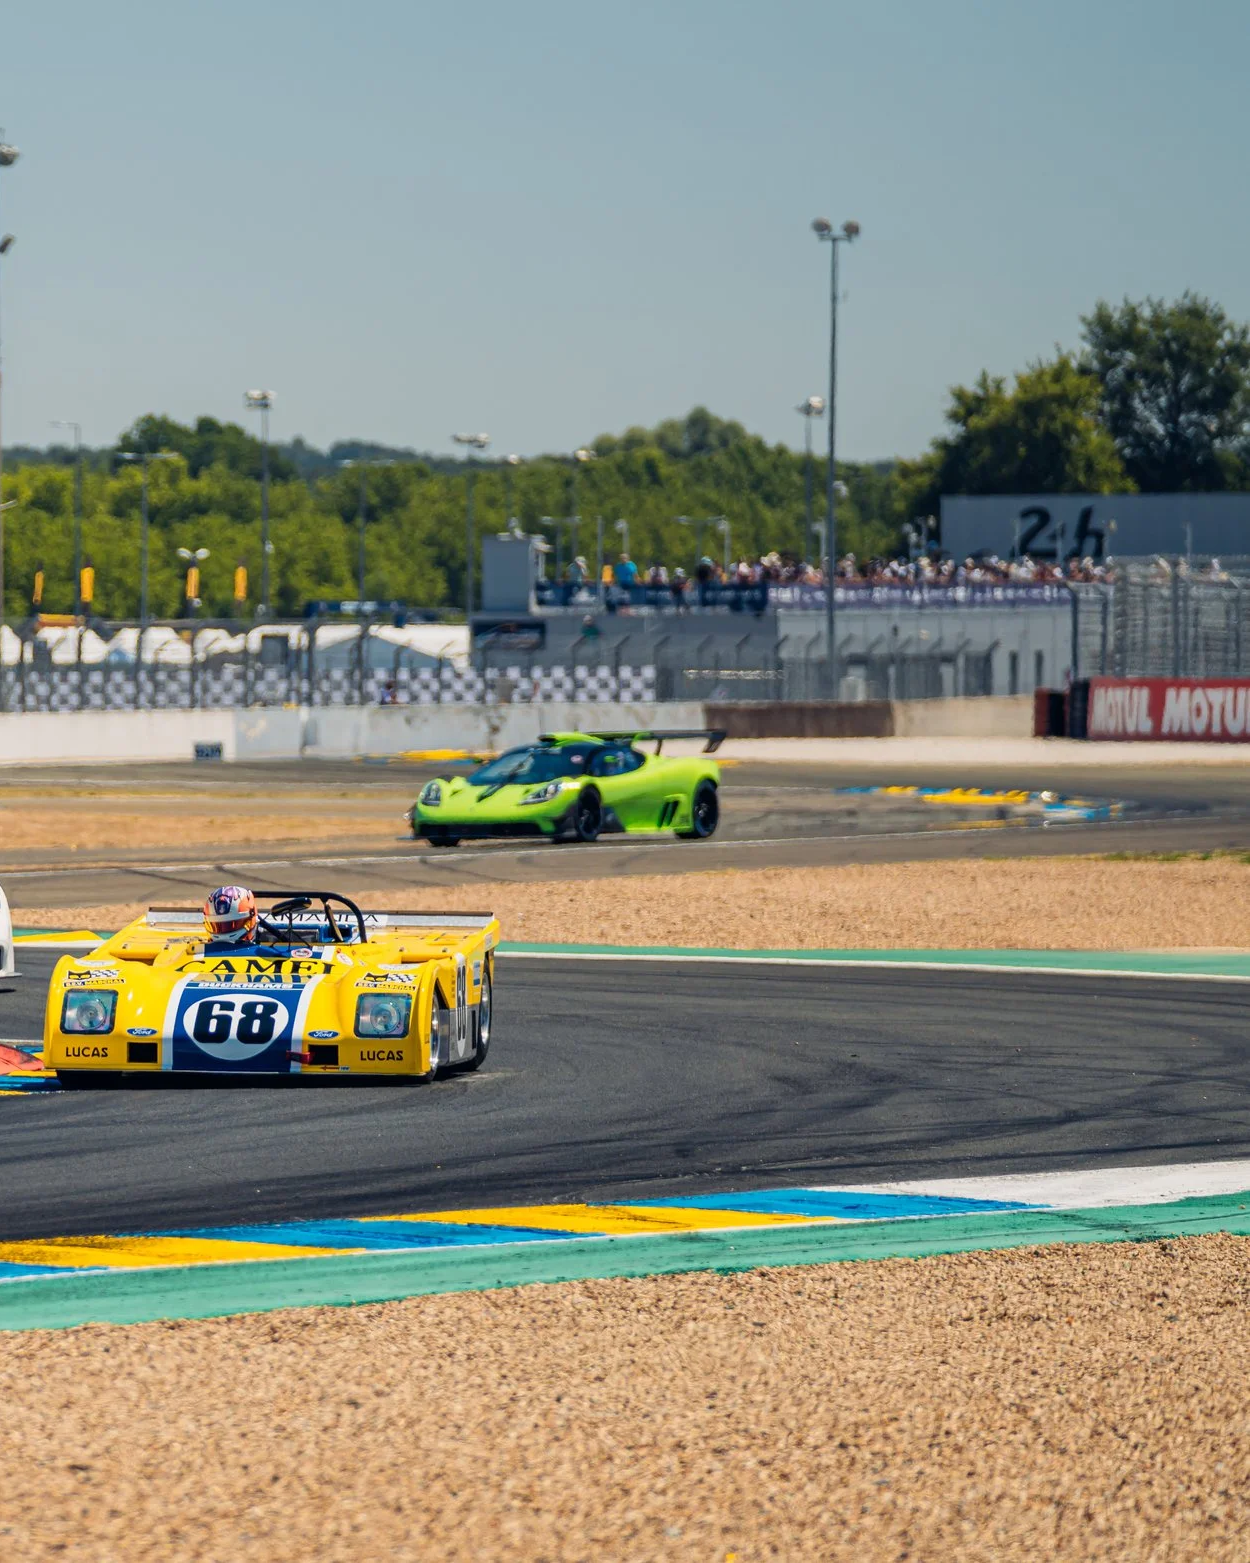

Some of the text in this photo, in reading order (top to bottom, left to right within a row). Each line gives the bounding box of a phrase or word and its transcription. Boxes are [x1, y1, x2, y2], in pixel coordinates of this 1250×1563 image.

[1091, 686, 1250, 737] MOTUL MOTU
[192, 1000, 279, 1045] 68
[132, 1028, 153, 1036] Ford
[65, 1046, 109, 1058] LUCAS
[360, 1050, 404, 1062] LUCAS
